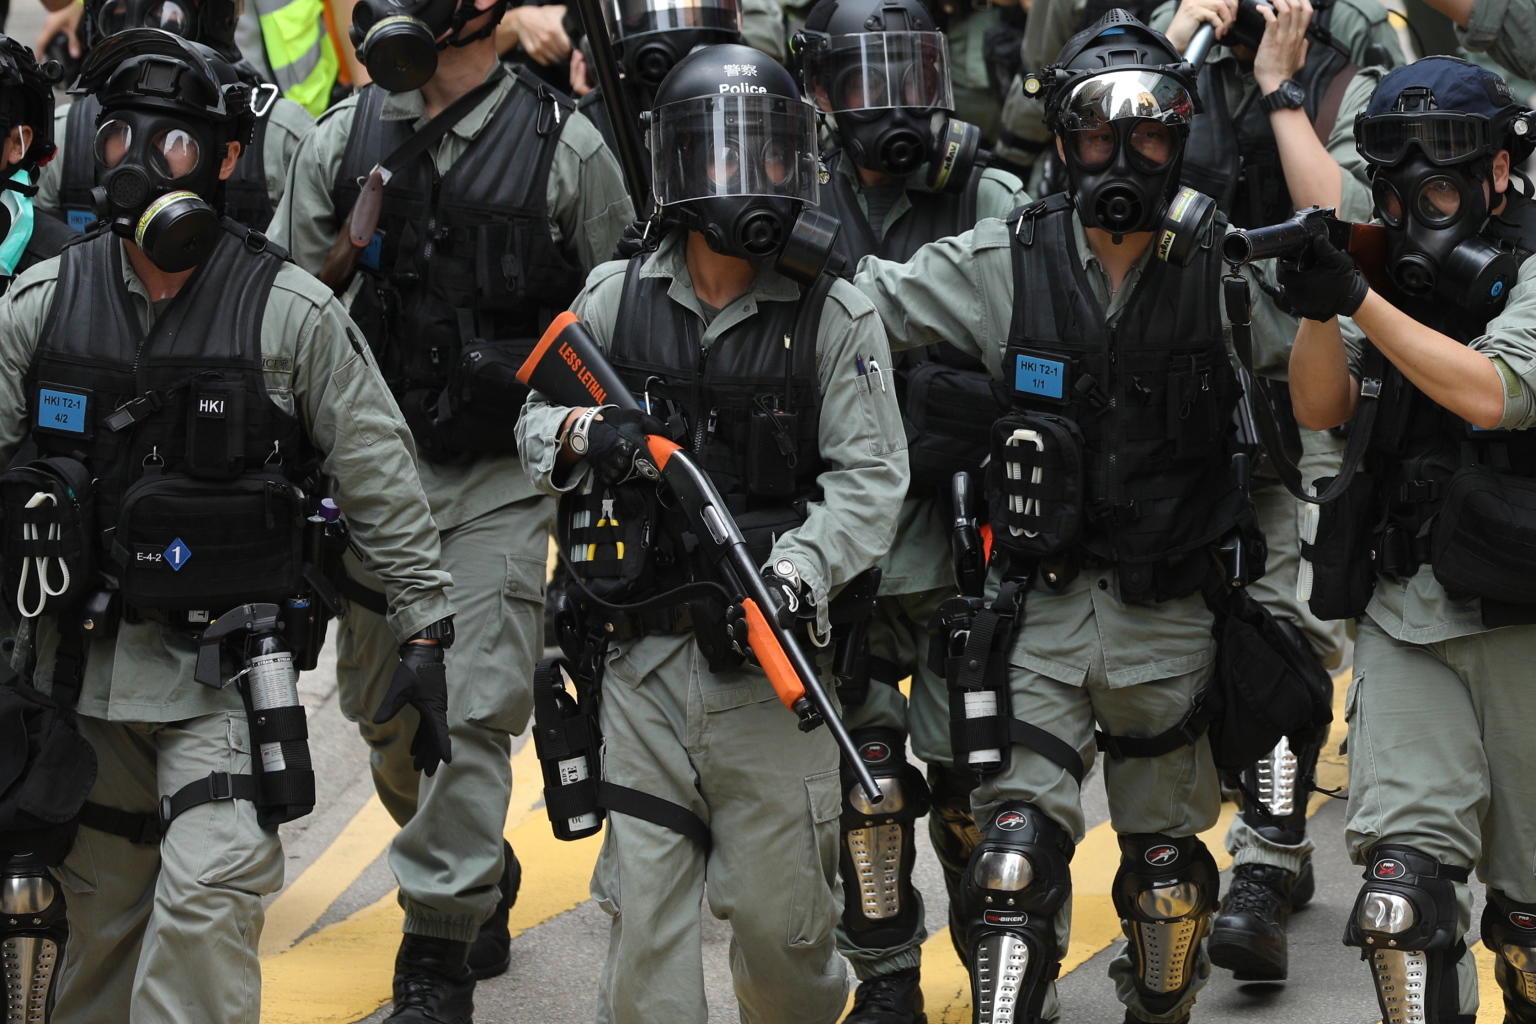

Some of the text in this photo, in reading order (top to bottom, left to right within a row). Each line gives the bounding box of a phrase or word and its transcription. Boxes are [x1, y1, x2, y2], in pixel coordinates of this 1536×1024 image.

[724, 64, 758, 77] 警察
[719, 83, 767, 95] Police
[559, 341, 608, 406] LESS LETHAL
[1021, 360, 1058, 376] HKI T2-1
[1032, 378, 1045, 389] 1/1
[44, 395, 81, 410] HKI T2-1
[200, 399, 224, 413] HKI
[55, 414, 69, 424] 4/2
[136, 552, 162, 562] E-4-2
[172, 546, 181, 564] 1
